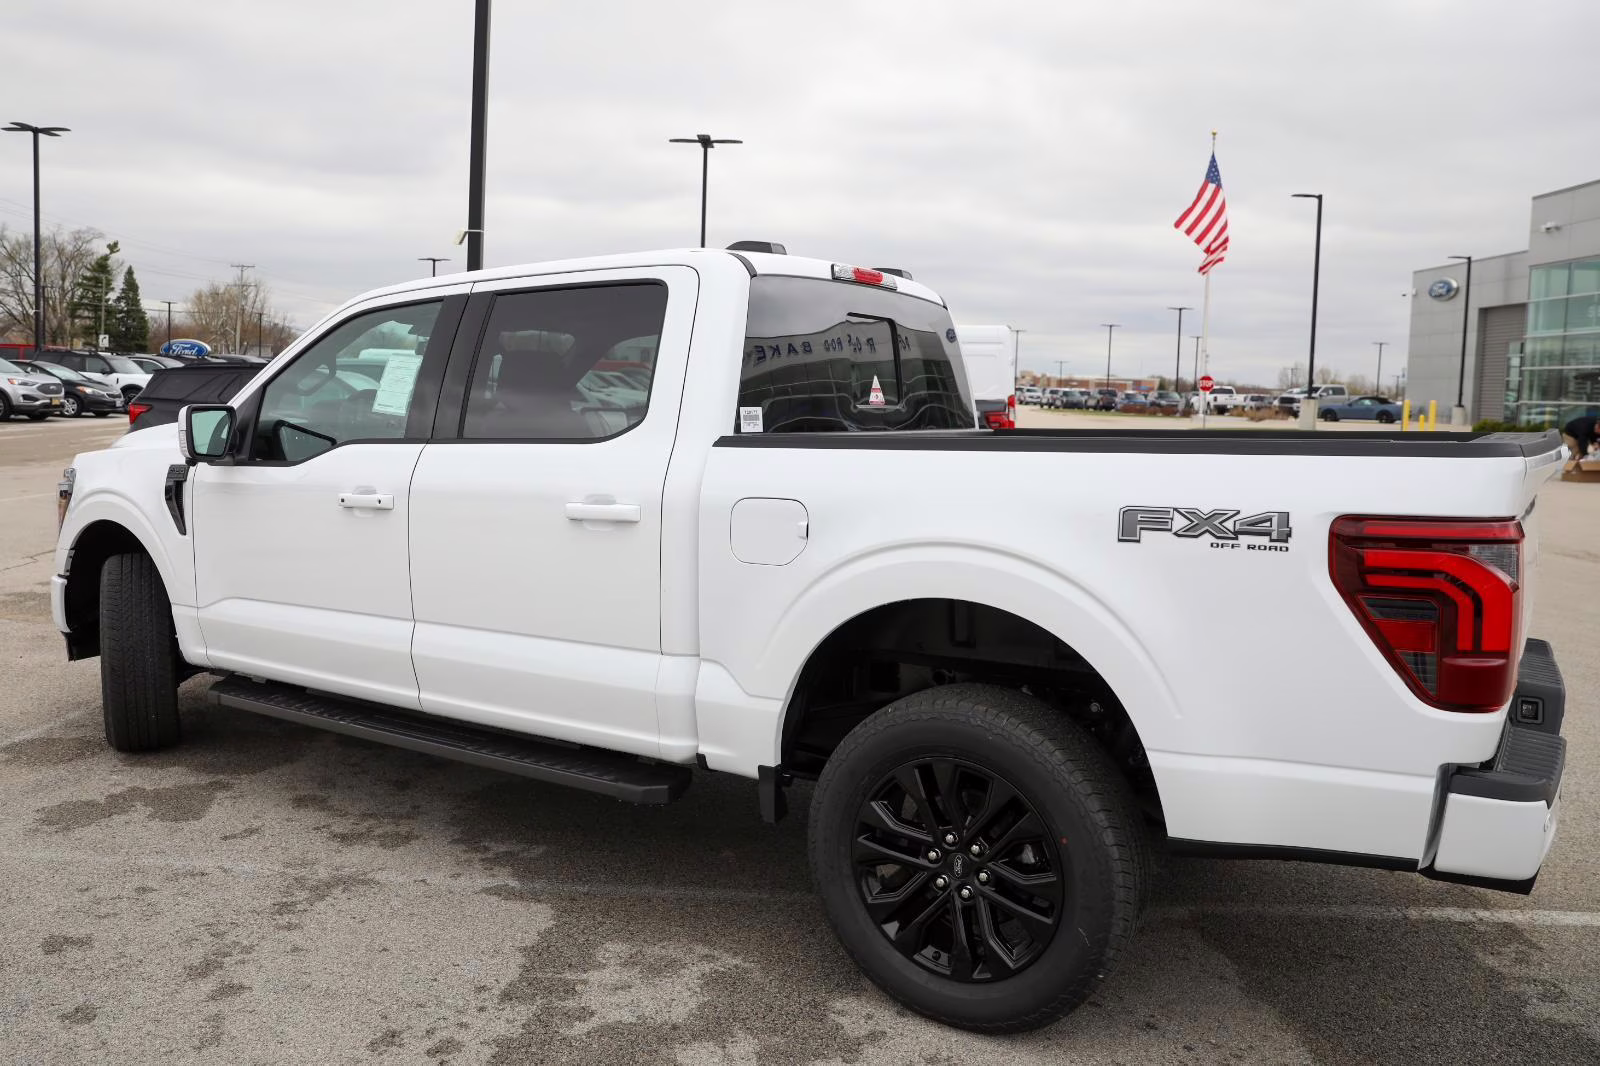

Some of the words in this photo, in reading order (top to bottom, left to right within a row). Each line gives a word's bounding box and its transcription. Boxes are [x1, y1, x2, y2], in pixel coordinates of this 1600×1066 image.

[170, 343, 199, 356] Ford
[1199, 379, 1213, 388] STOP
[1118, 505, 1292, 544] FX4
[1210, 542, 1241, 550] OFF
[1247, 544, 1289, 553] ROAD
